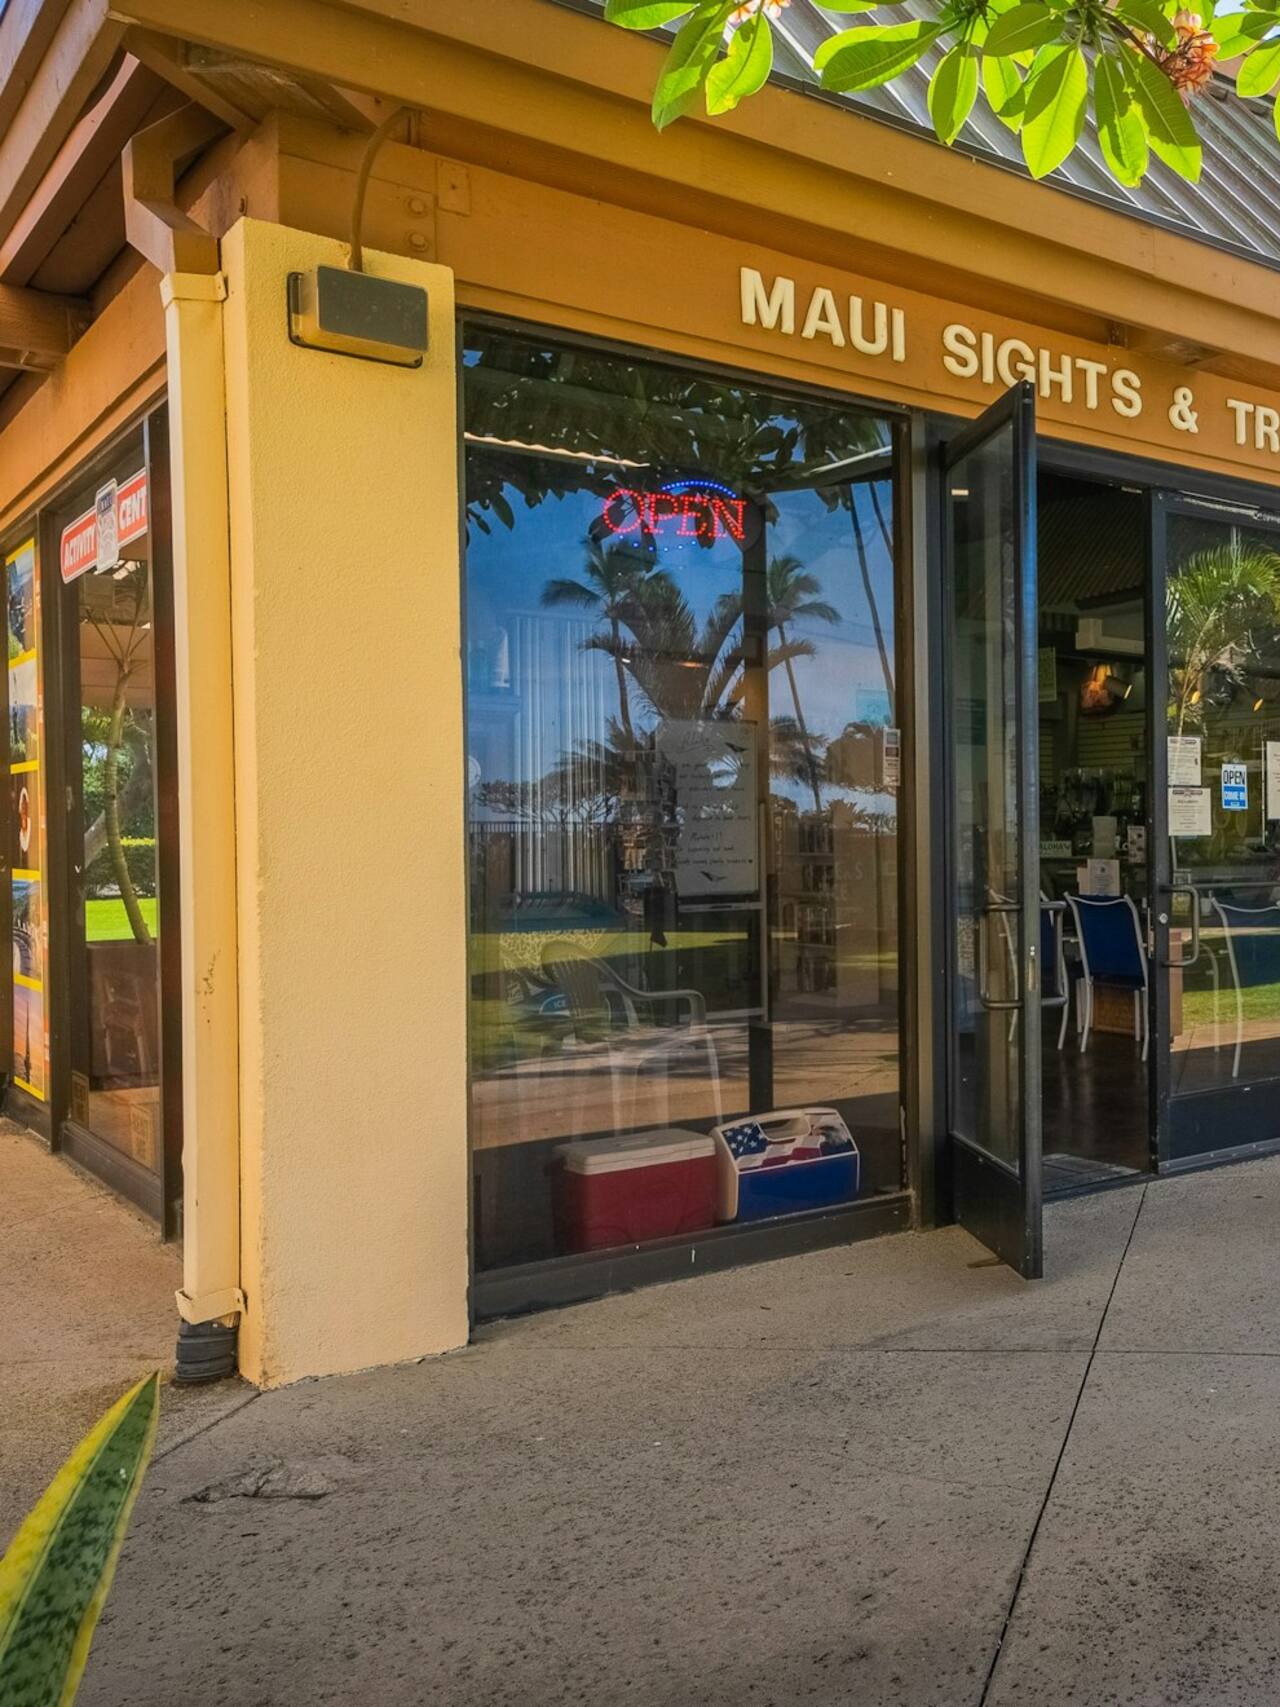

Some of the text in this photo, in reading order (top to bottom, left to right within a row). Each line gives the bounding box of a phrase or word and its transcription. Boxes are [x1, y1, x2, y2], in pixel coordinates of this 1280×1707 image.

[740, 267, 905, 361] MAUI
[942, 324, 1143, 419] SIGHTS
[1168, 387, 1200, 434] &
[603, 488, 746, 540] OPEN
[1223, 770, 1245, 785] OPEN
